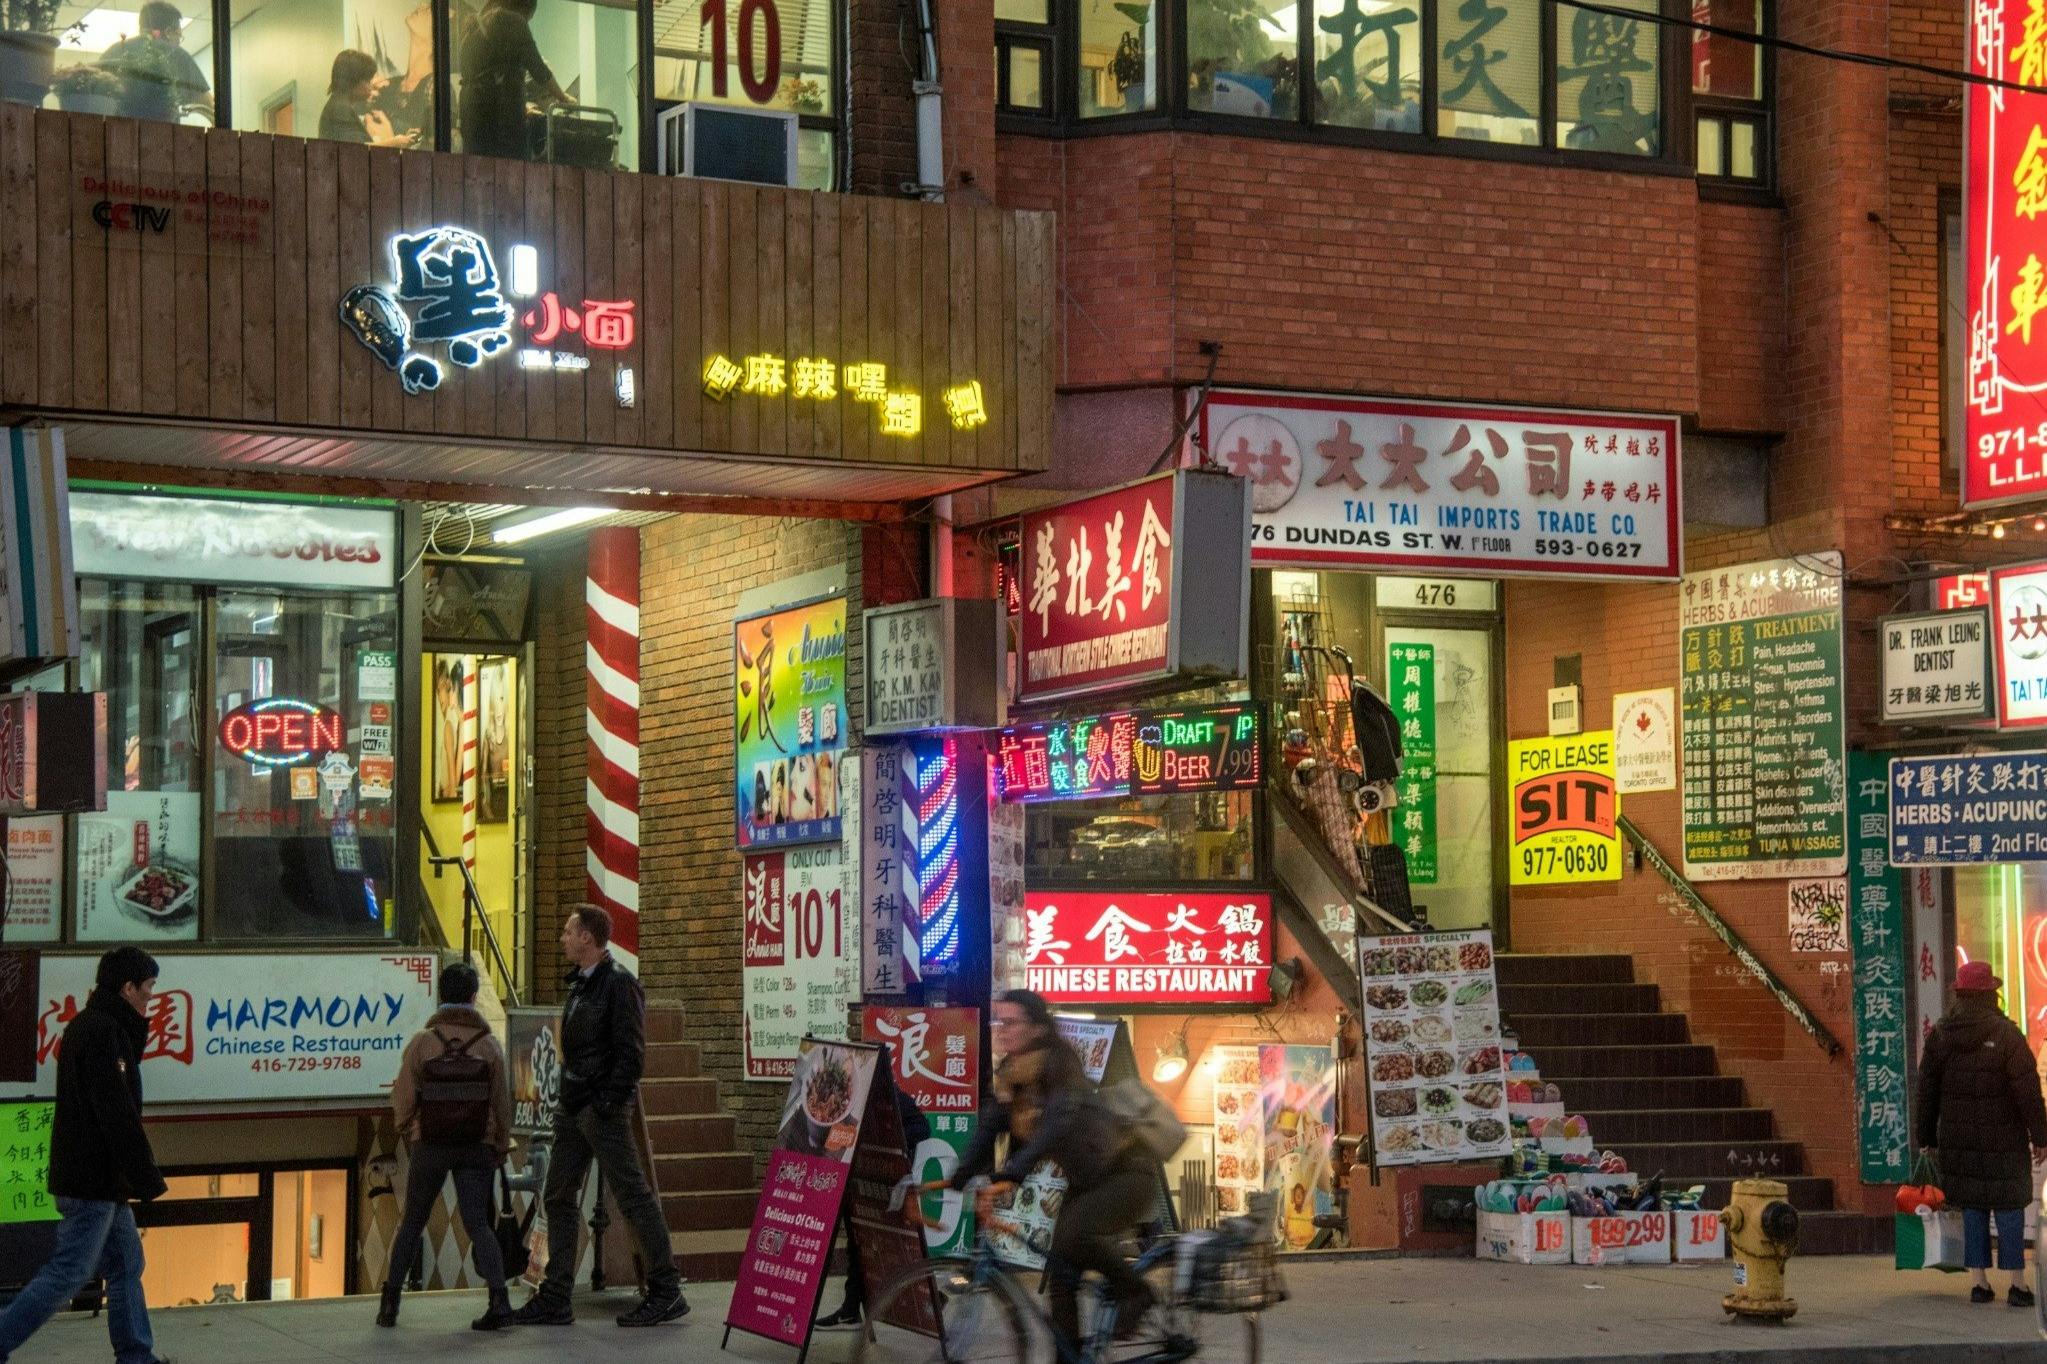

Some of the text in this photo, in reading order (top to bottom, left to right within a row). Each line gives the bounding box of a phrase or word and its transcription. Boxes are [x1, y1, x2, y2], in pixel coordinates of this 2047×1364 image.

[92, 200, 171, 236] CCTV
[523, 291, 635, 348] 小面
[1343, 500, 1637, 537] TAI TAI IMPORTS TRADE CO.
[1251, 524, 1642, 559] 76 DUNDAS ST. W. FLOOR 593-0627
[1415, 583, 1457, 606] 476
[1683, 604, 1725, 626] HERBS
[1728, 600, 1738, 620] &
[1753, 612, 1837, 640] TREATMENT
[1889, 622, 1981, 651] DR. FRANK LEUNG
[363, 655, 392, 667] PASS
[1753, 641, 1816, 660] Pain, Headache
[1914, 650, 1955, 673] DENTIST
[1787, 656, 1826, 673] Insomnia
[1783, 674, 1836, 694] Hypertension
[1889, 681, 1982, 705] 牙醫梁旭光
[2010, 678, 2031, 702] TAI
[881, 693, 938, 722] DENTIST
[1794, 694, 1826, 708] Asthma
[225, 713, 340, 751] OPEN
[363, 727, 388, 738] FREE
[1163, 719, 1213, 746] DRAFT
[1791, 730, 1816, 746] Injury
[1164, 749, 1211, 782] BEER
[1520, 743, 1609, 772] FOR LEASE
[1624, 776, 1667, 788] TORONTO OFFICE
[1793, 764, 1825, 780] Cancer
[1896, 760, 2047, 798] 中醫針灸跌打
[1755, 783, 1815, 800] Skin disorders
[1520, 779, 1609, 830] SIT
[1798, 800, 1845, 817] Overweight
[1895, 802, 1952, 825] HERBS
[1755, 818, 1809, 835] Hemorrhoids
[1551, 834, 1578, 844] REALTOR
[1791, 835, 1841, 850] MASSAGE
[1992, 832, 2020, 853] 2nd
[792, 848, 832, 869] ONLY CUT
[1523, 843, 1609, 877] 977-0630
[1164, 902, 1264, 936] 火鍋
[1423, 933, 1472, 944] SPECIALTY
[766, 978, 779, 992] Color
[1026, 967, 1257, 993] HINESE RESTAURANT
[206, 993, 404, 1033] HARMONY
[766, 1005, 779, 1018] Perm
[766, 1031, 786, 1049] Straight
[807, 1021, 832, 1036] Shampoo
[206, 1033, 404, 1056] Chinese Restaurant
[251, 1056, 362, 1073] 416-729-9788
[936, 1093, 973, 1108] HAIR
[514, 1100, 534, 1127] BBQ
[764, 1205, 826, 1232] Delicious Of China
